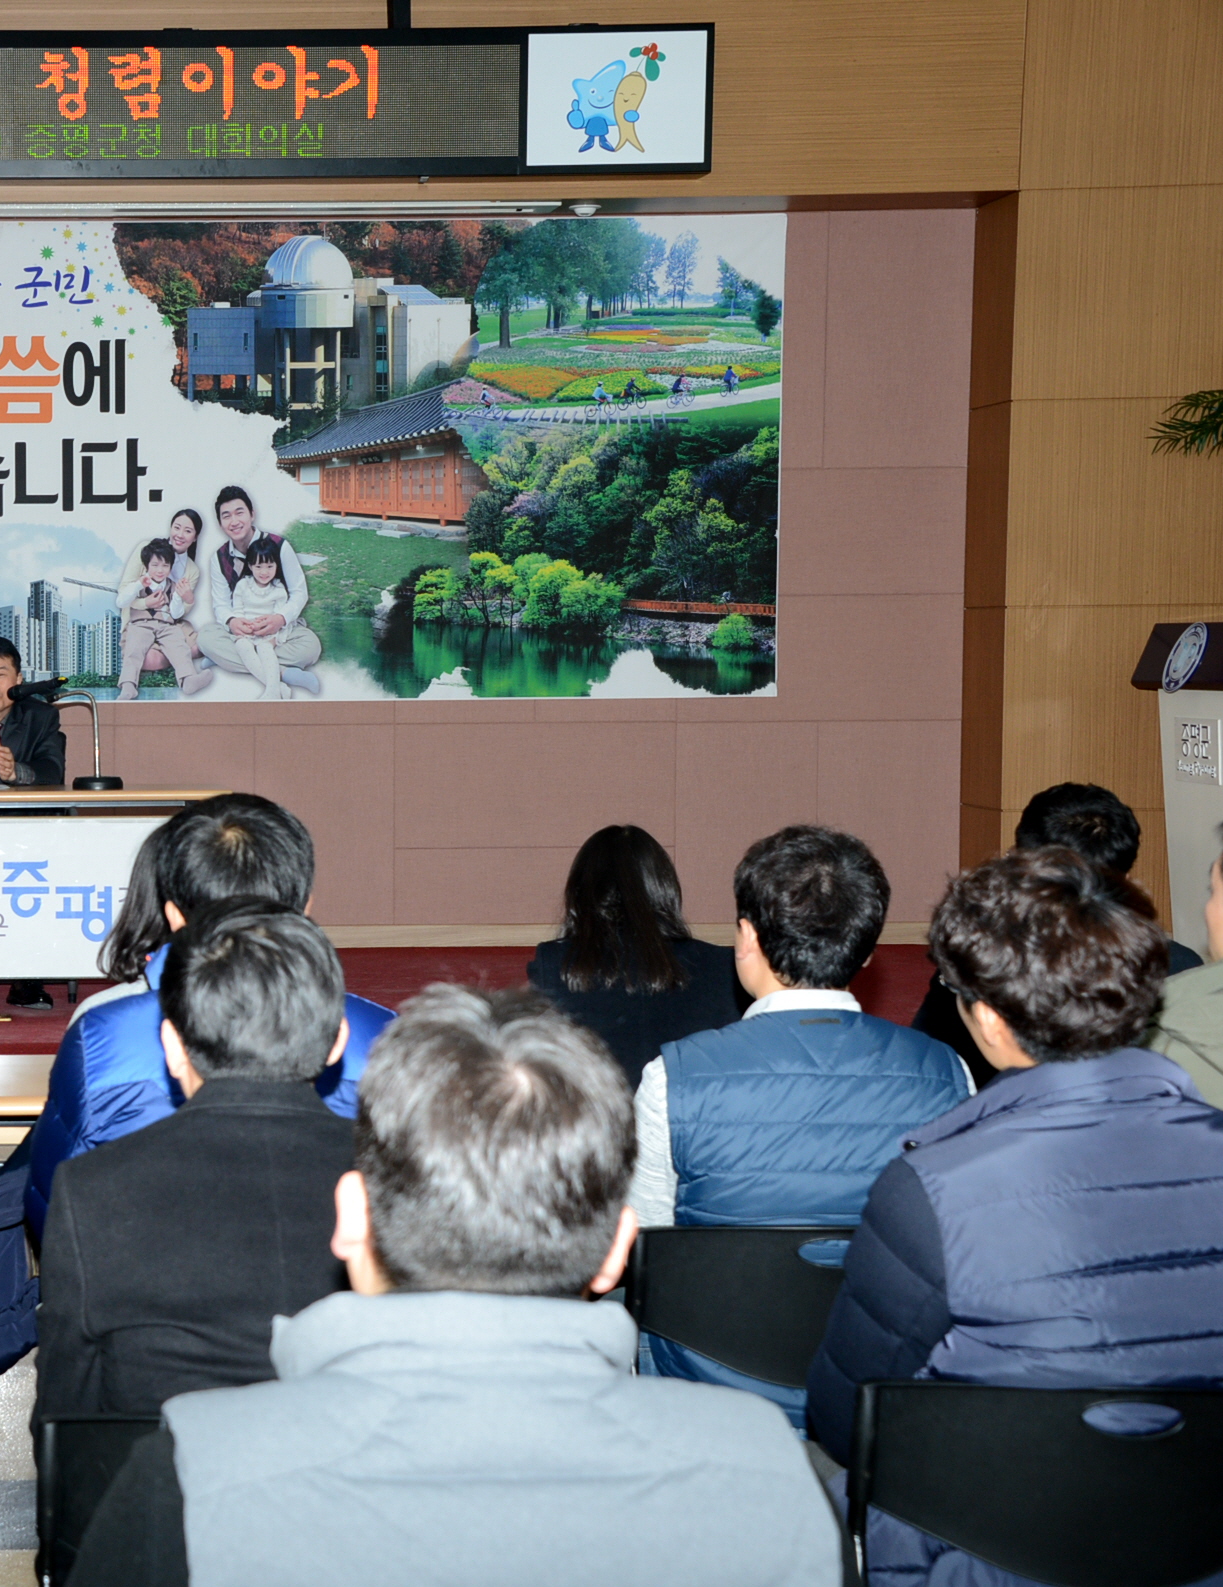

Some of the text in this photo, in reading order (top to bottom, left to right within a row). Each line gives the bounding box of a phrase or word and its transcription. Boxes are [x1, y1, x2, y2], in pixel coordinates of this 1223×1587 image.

[25, 124, 162, 158] 증평군청
[187, 123, 325, 158] 대회의실
[14, 264, 94, 308] 군민
